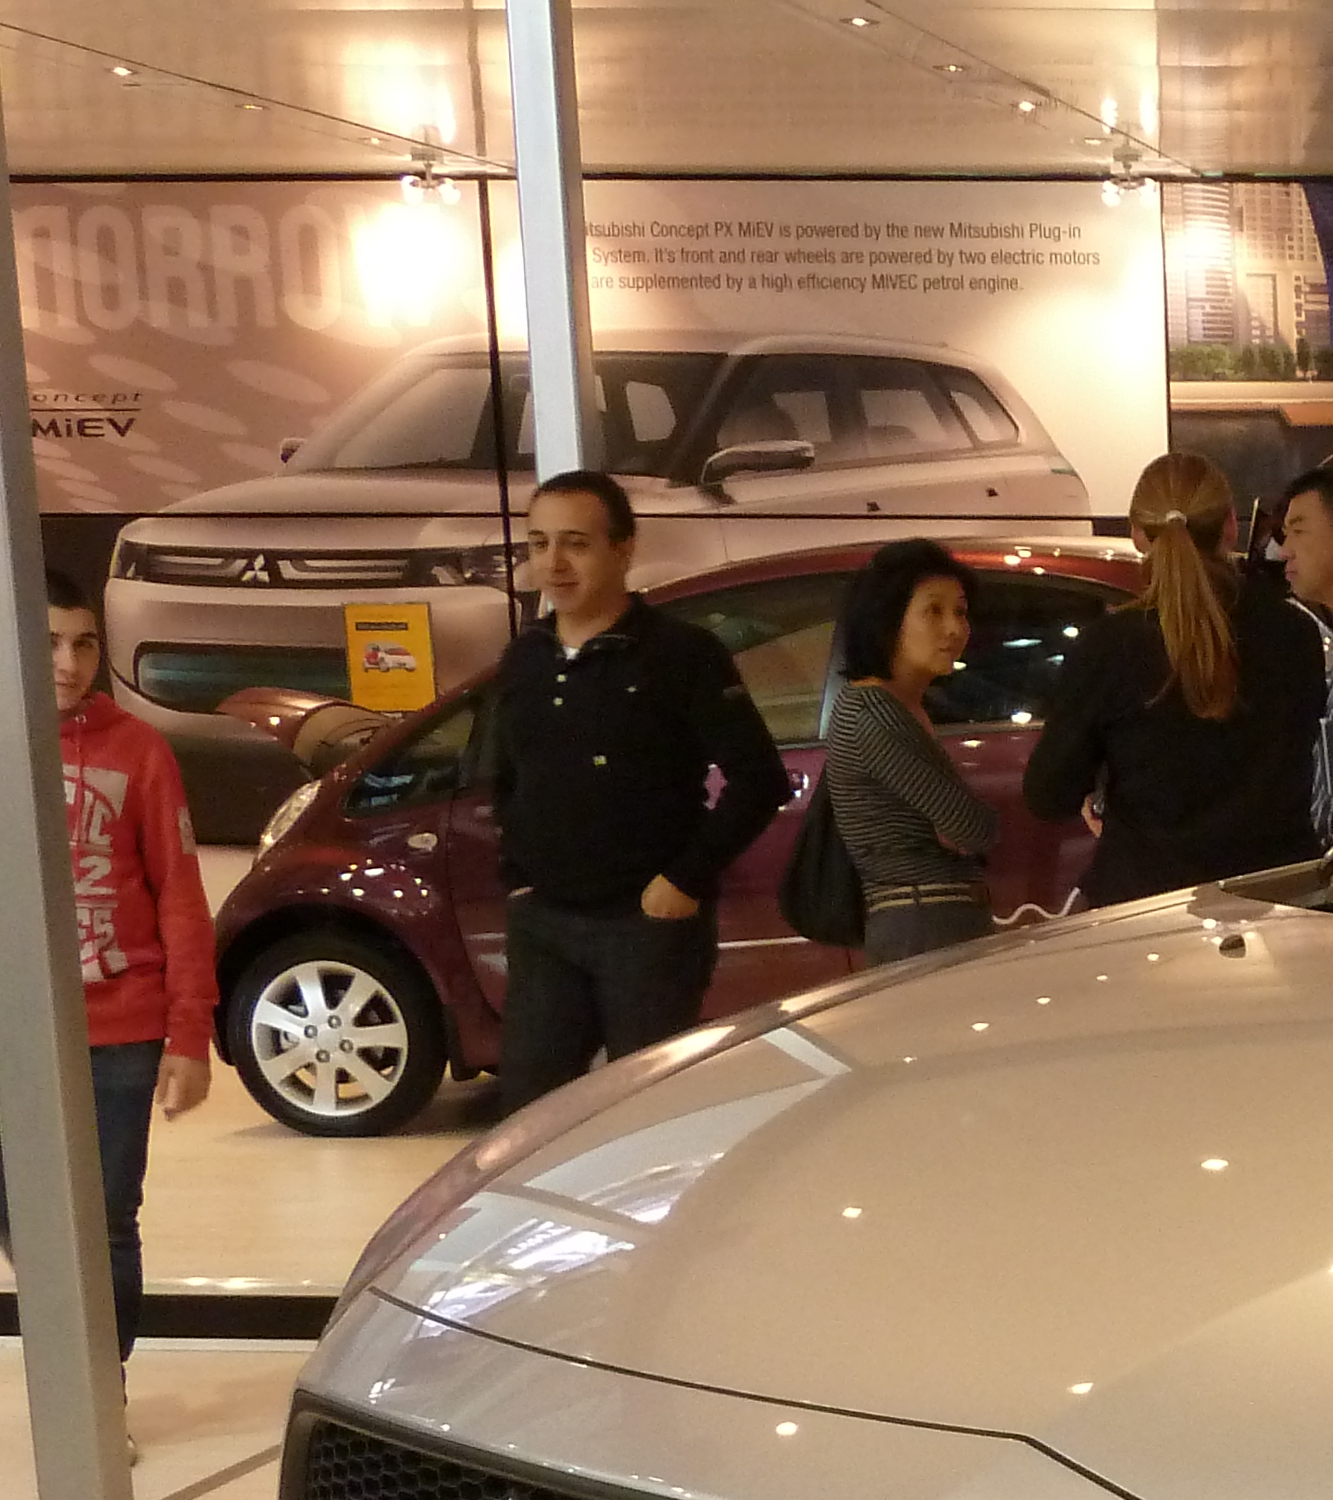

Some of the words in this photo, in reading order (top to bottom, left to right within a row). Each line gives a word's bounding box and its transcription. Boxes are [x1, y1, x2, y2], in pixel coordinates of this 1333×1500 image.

[585, 221, 645, 238] itsubishi
[650, 222, 709, 241] Concept
[714, 222, 733, 238] PX
[738, 222, 774, 238] MiEV
[779, 222, 791, 238] is
[796, 222, 859, 241] powered
[864, 223, 881, 241] by
[886, 223, 909, 239] the
[914, 225, 945, 239] new
[949, 222, 1025, 239] Mitsubishi
[1029, 223, 1081, 242] Plug-in
[654, 248, 676, 264] It's
[680, 248, 714, 264] front
[719, 248, 746, 264] and
[750, 250, 779, 264] rear
[784, 248, 836, 264] wheels
[840, 251, 864, 264] are
[868, 249, 933, 267] powered
[937, 249, 953, 267] by
[959, 250, 986, 265] two
[991, 249, 1045, 265] electric
[1049, 250, 1100, 265] motors
[591, 276, 614, 290] are
[618, 274, 721, 293] supplemented
[726, 274, 744, 292] by
[749, 276, 757, 290] a
[761, 274, 793, 293] high
[797, 274, 867, 293] efficiency
[923, 275, 964, 293] petrol
[969, 275, 1024, 294] engine.
[32, 392, 143, 404] oncept
